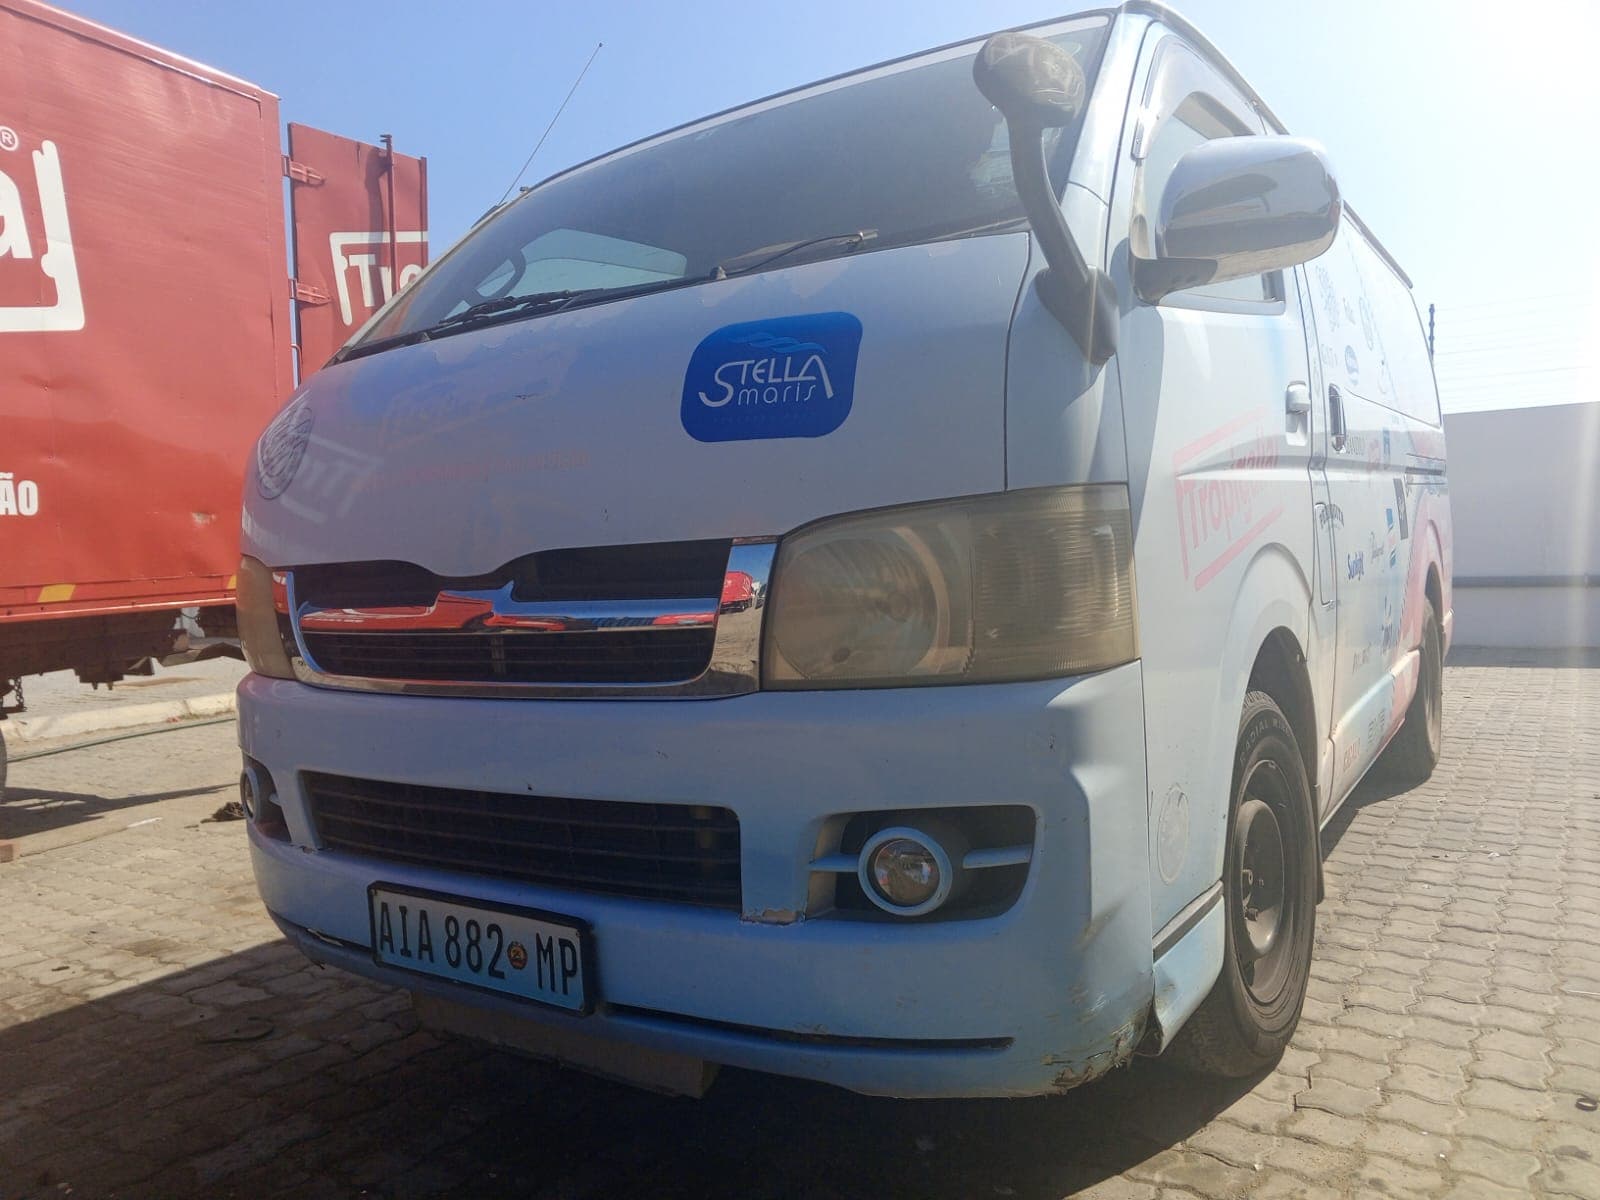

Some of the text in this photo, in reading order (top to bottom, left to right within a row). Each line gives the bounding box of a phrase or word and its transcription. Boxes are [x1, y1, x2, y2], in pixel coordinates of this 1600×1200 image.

[699, 355, 834, 407] STELLA
[738, 383, 816, 406] maris
[380, 902, 578, 995] AIA 882 MP
